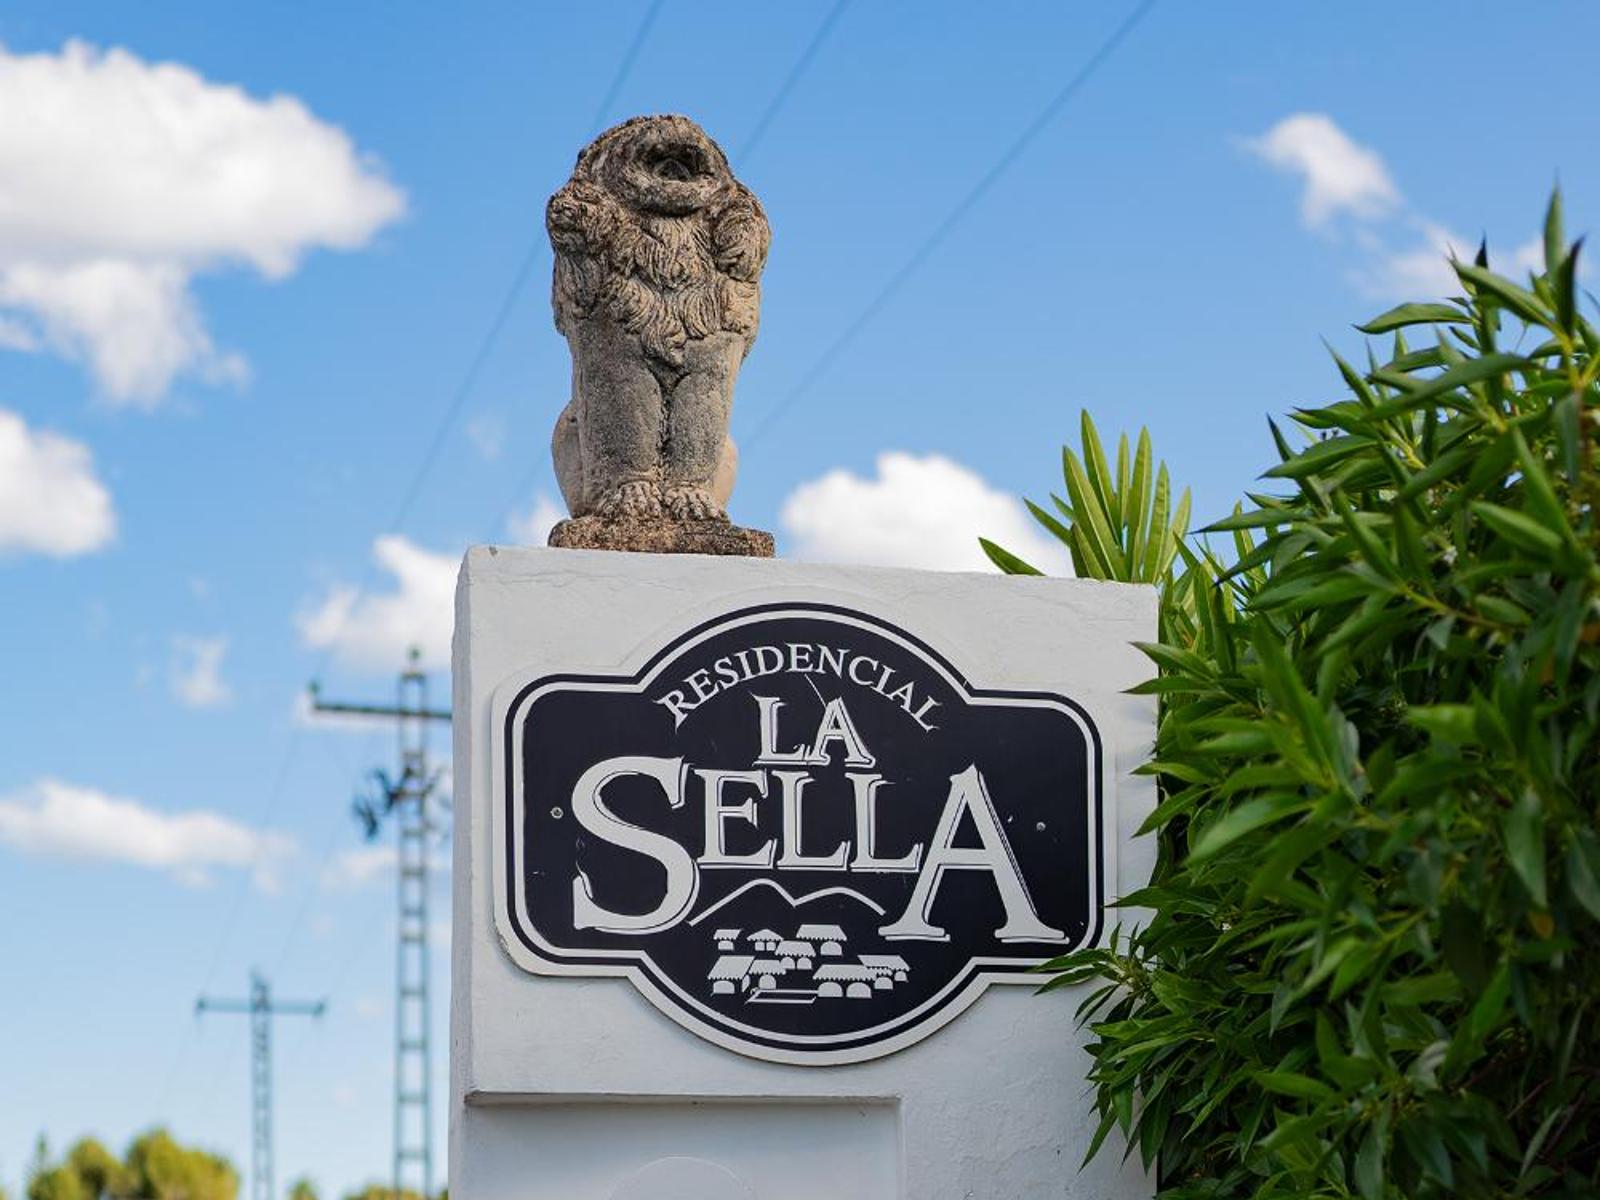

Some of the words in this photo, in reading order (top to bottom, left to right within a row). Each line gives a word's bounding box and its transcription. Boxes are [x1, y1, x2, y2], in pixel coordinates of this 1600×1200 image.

[656, 643, 939, 732] RESIDENCIAL
[752, 695, 875, 766] LA
[571, 755, 1070, 944] SELLA
